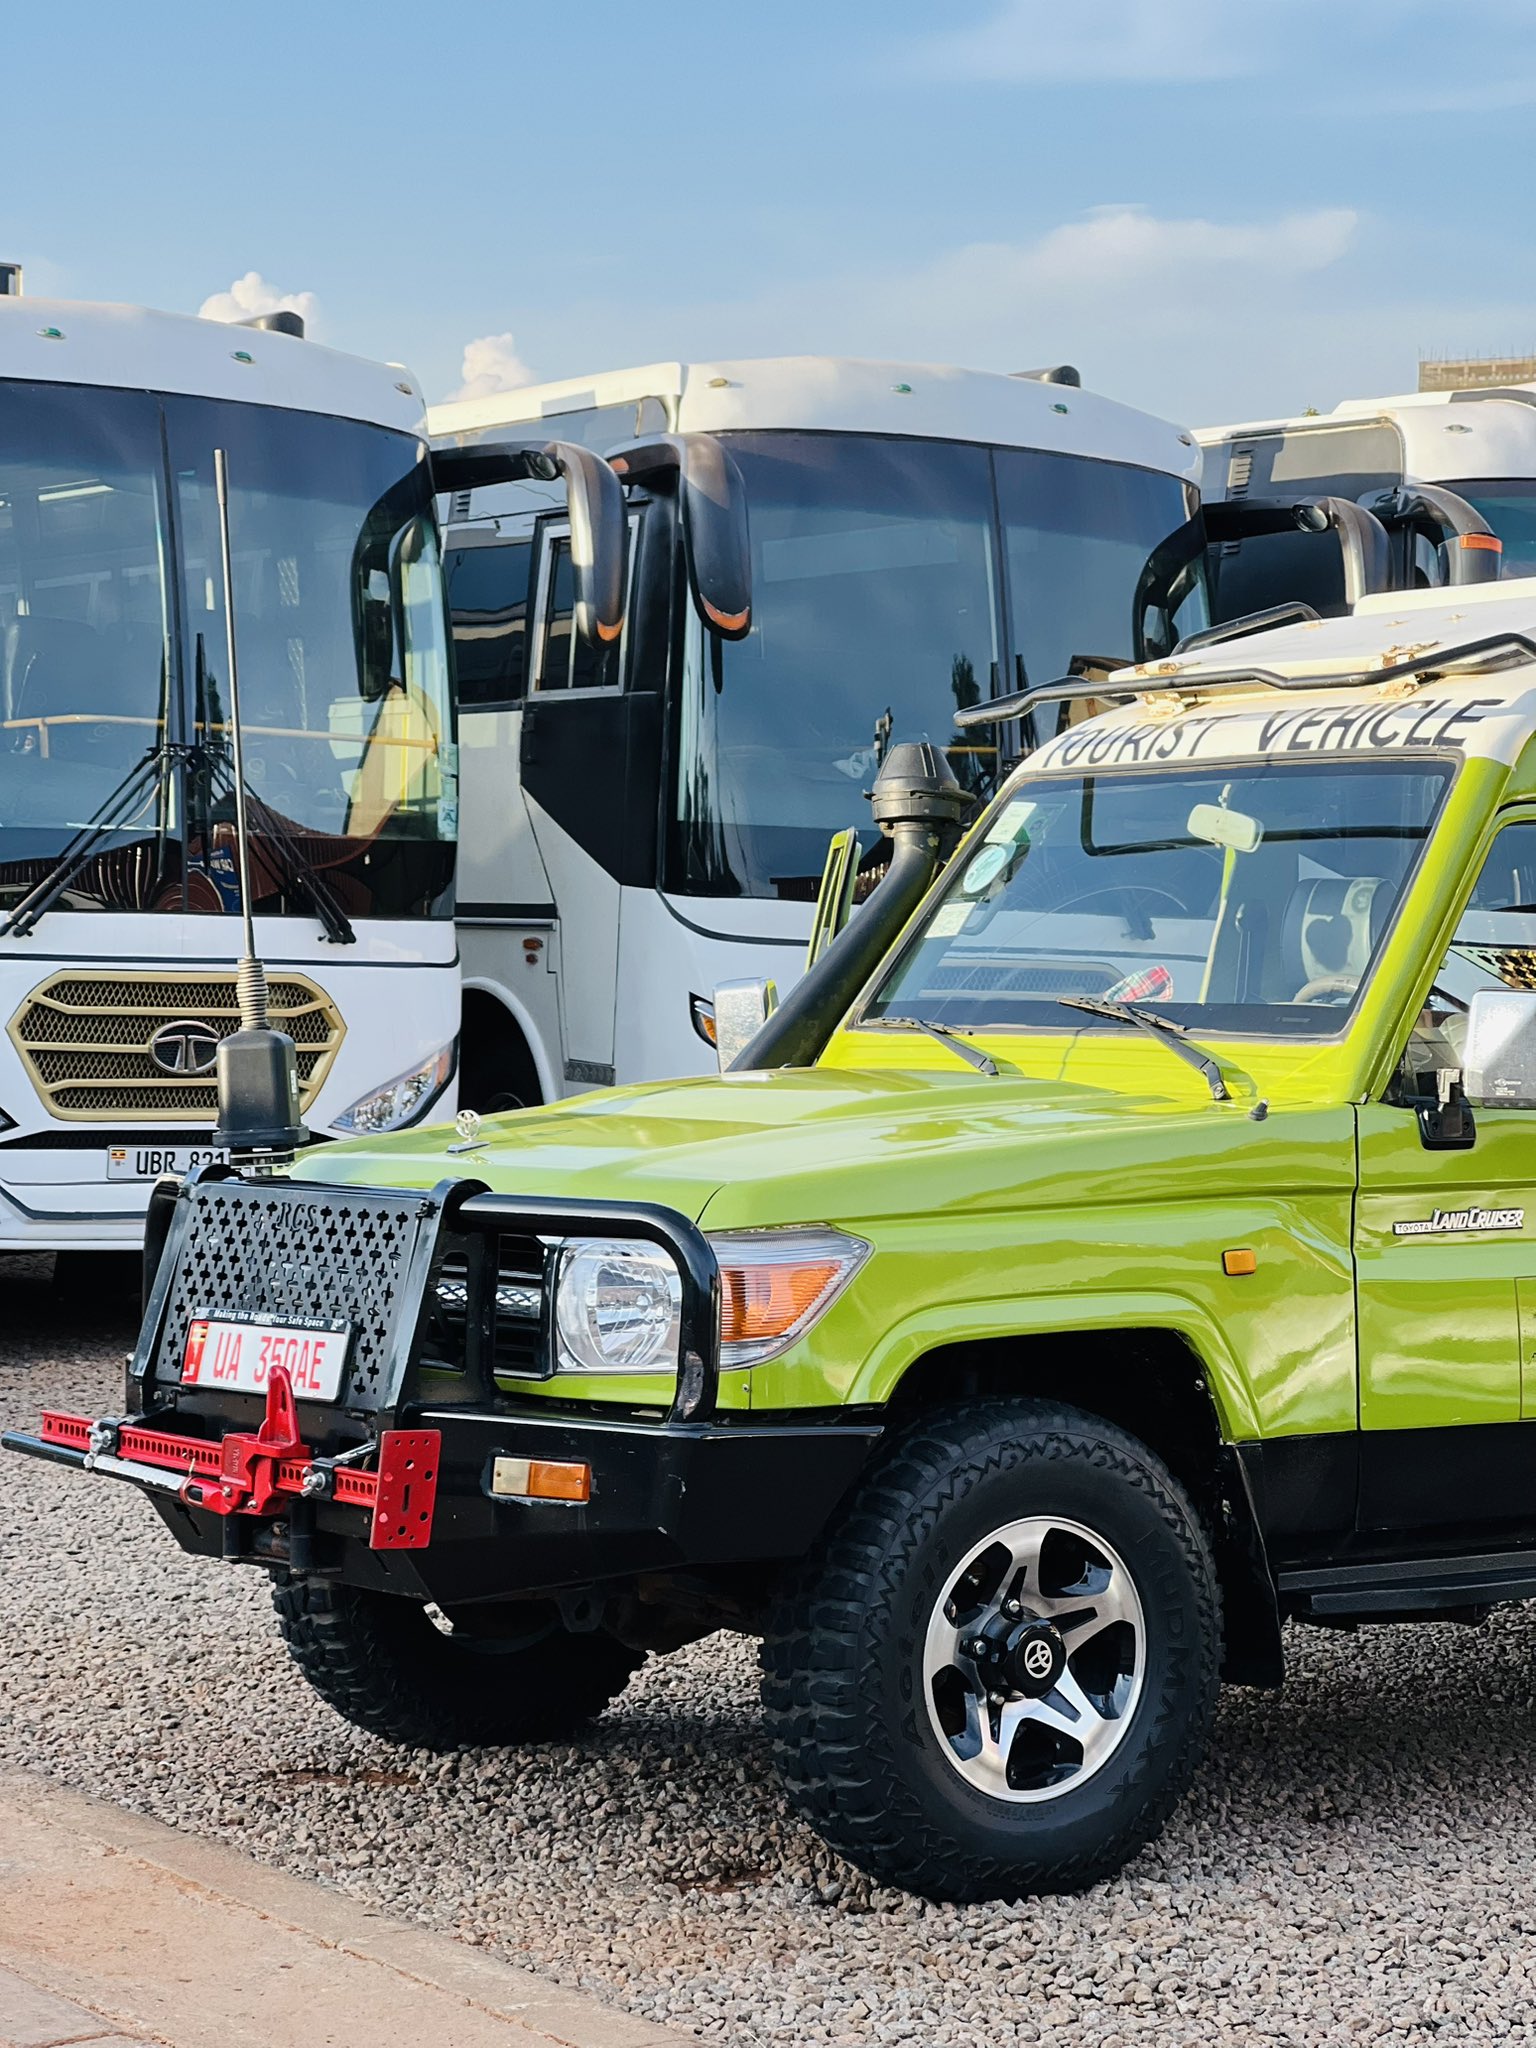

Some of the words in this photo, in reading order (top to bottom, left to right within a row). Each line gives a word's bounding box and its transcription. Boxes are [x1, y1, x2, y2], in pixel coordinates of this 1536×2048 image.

[1043, 714, 1240, 768] TOURIST
[1256, 698, 1507, 752] VEHICLE
[136, 1150, 176, 1175] UBR
[1397, 1223, 1430, 1233] TOYOTA
[213, 1309, 236, 1321] Making
[237, 1311, 249, 1321] the
[288, 1316, 303, 1326] Safe
[304, 1317, 325, 1328] Space
[213, 1331, 243, 1381] UA
